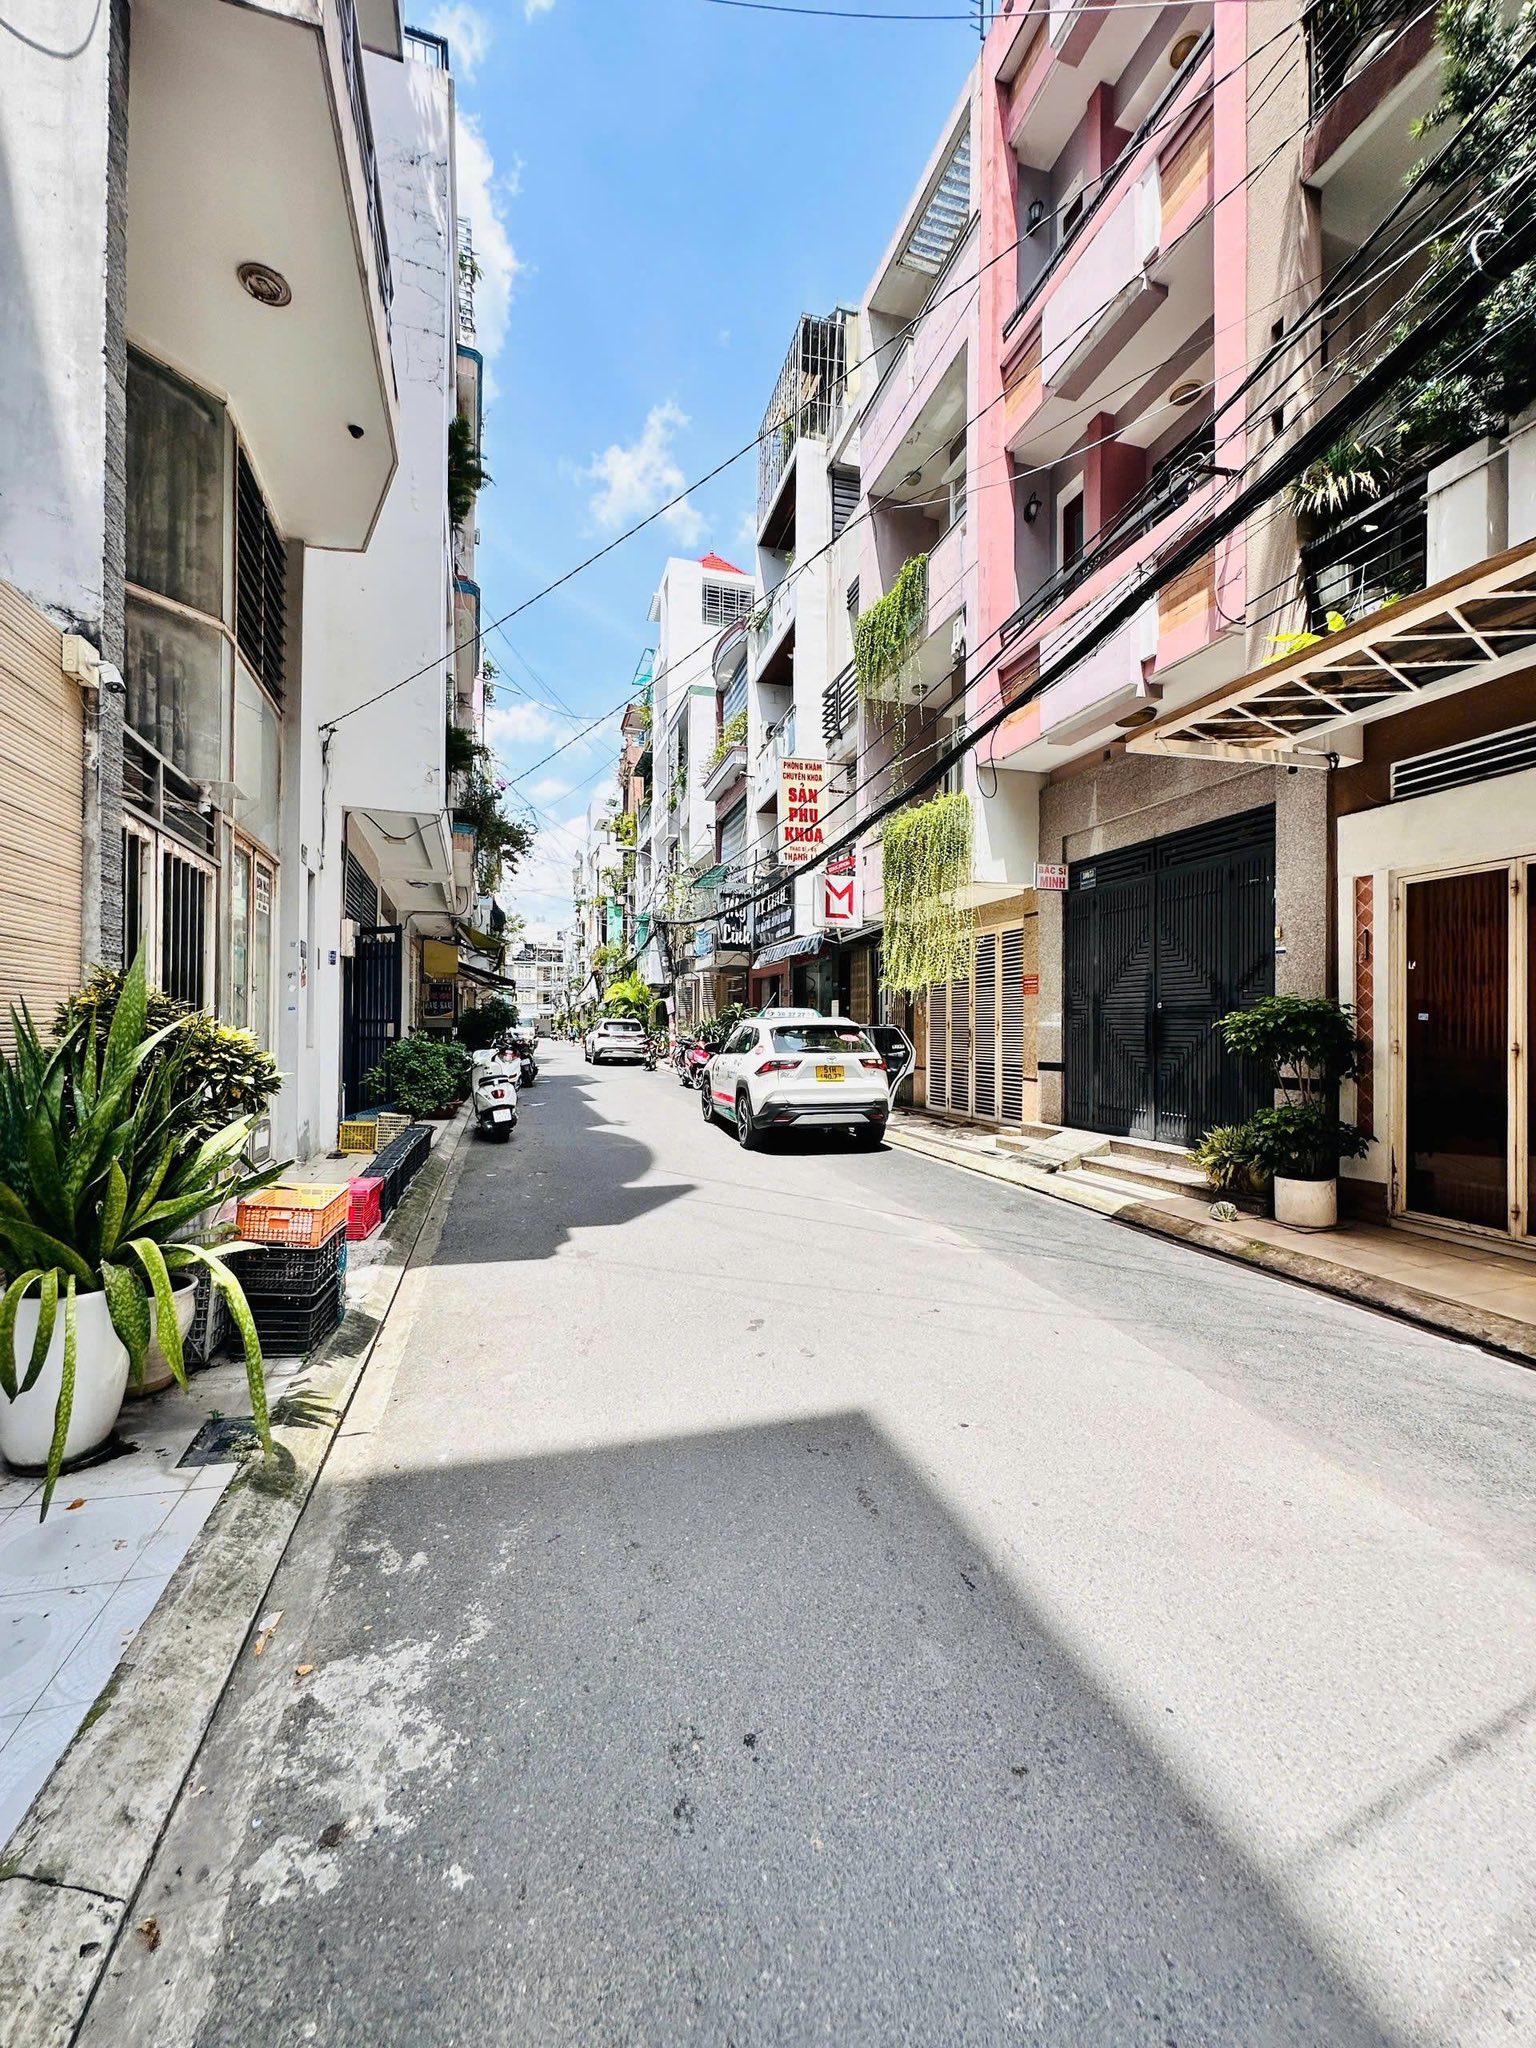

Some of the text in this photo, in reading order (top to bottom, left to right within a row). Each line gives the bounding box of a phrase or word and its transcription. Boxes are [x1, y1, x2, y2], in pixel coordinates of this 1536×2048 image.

[806, 774, 823, 782] KHOA
[788, 782, 818, 804] SẢN
[784, 826, 823, 843] KHOA
[1040, 876, 1065, 888] MINH
[720, 923, 752, 946] Linh
